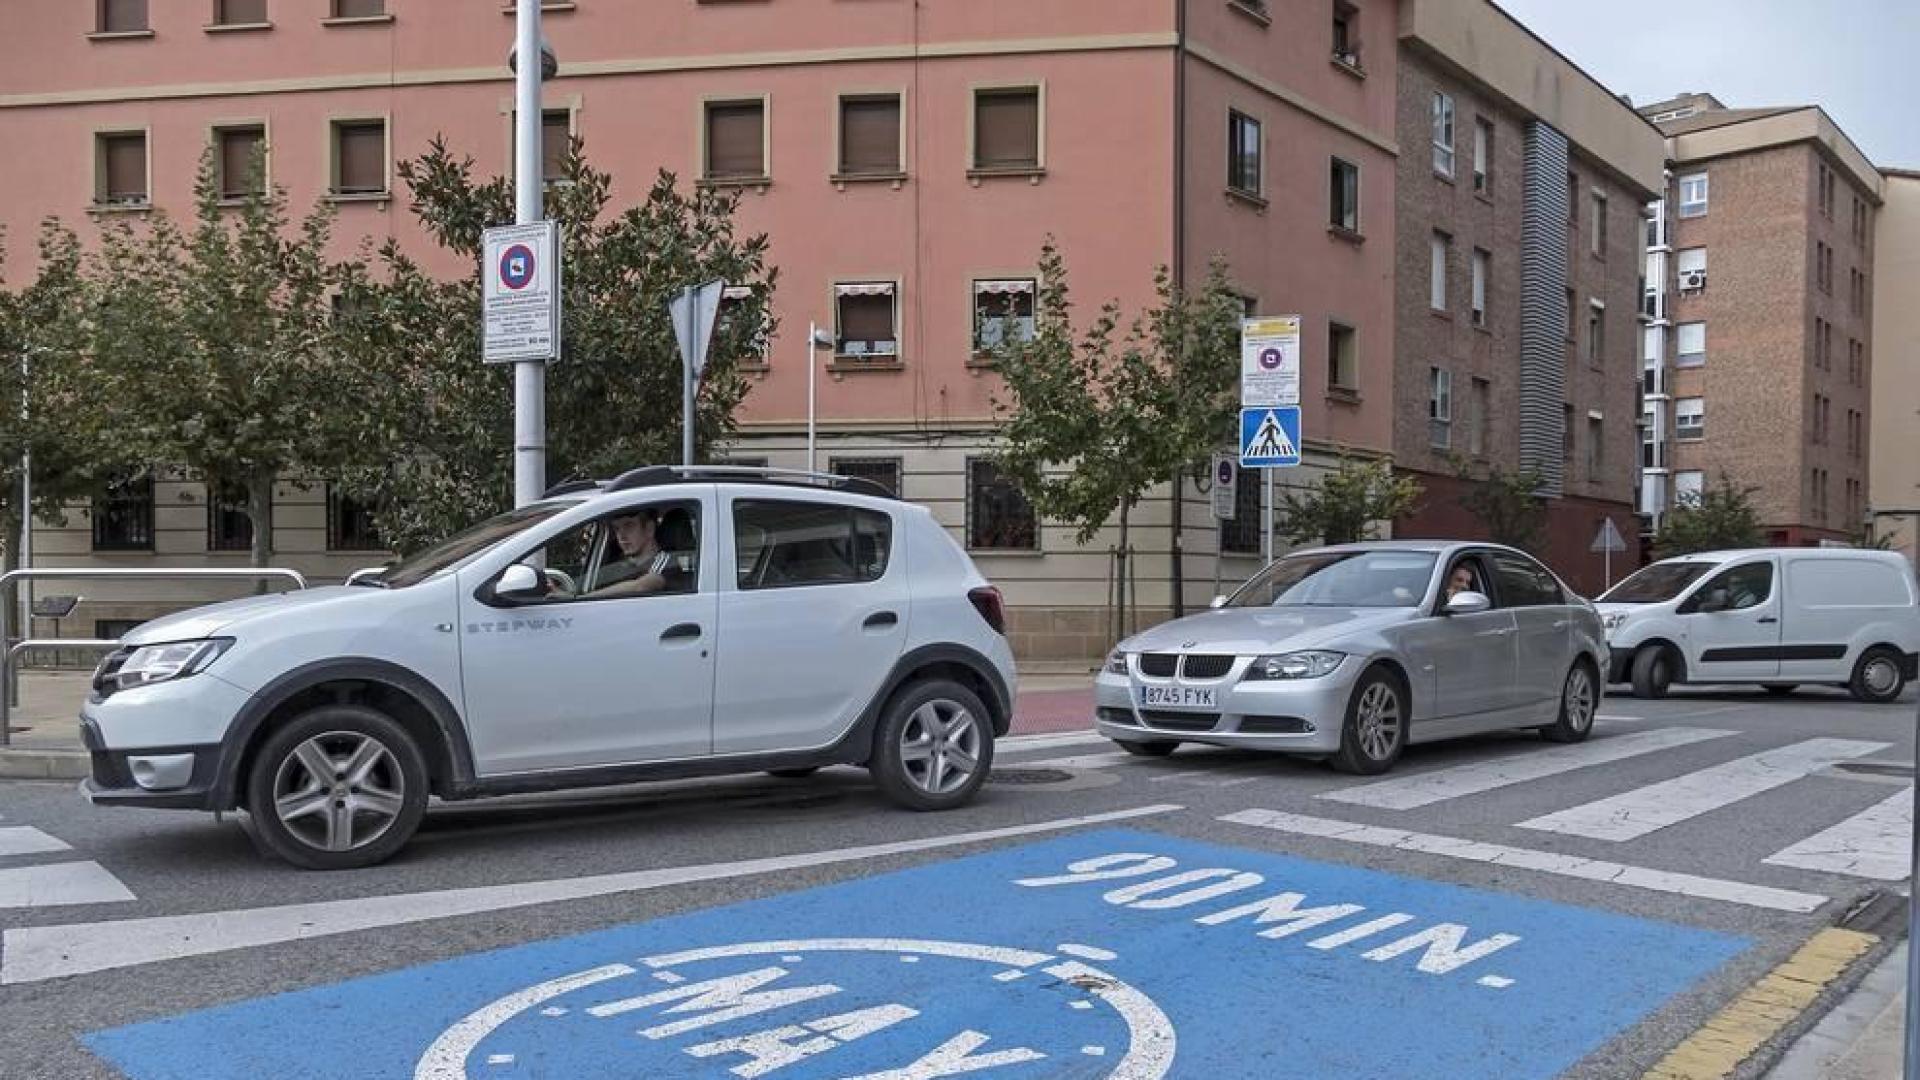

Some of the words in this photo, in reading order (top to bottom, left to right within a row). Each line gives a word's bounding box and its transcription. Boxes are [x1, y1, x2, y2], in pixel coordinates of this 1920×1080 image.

[467, 618, 573, 633] STEPWAY
[1147, 687, 1180, 703] 8745
[1184, 688, 1211, 704] FYK
